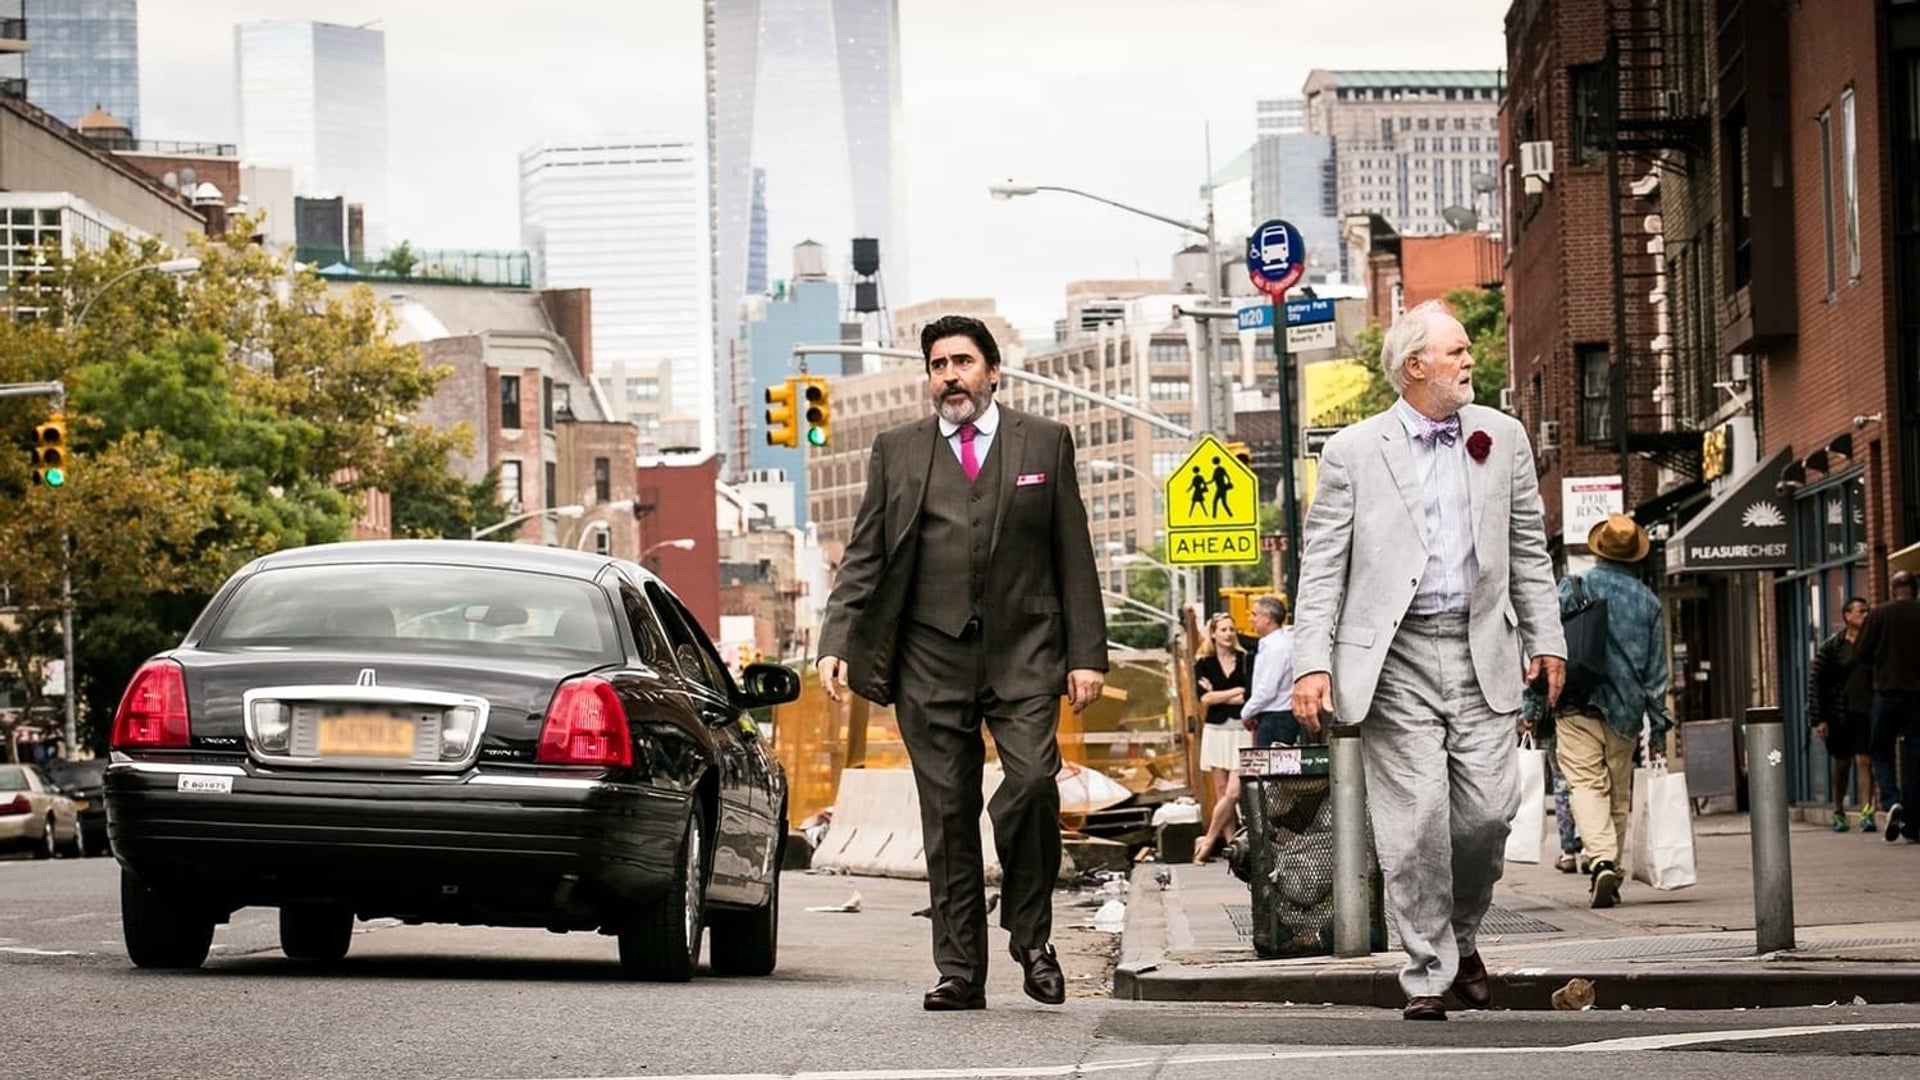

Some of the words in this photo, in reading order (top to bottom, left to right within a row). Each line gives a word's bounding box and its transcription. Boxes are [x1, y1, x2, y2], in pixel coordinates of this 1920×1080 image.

[1240, 308, 1263, 326] M20
[1581, 494, 1607, 504] FOR
[1176, 536, 1250, 554] AHEAD
